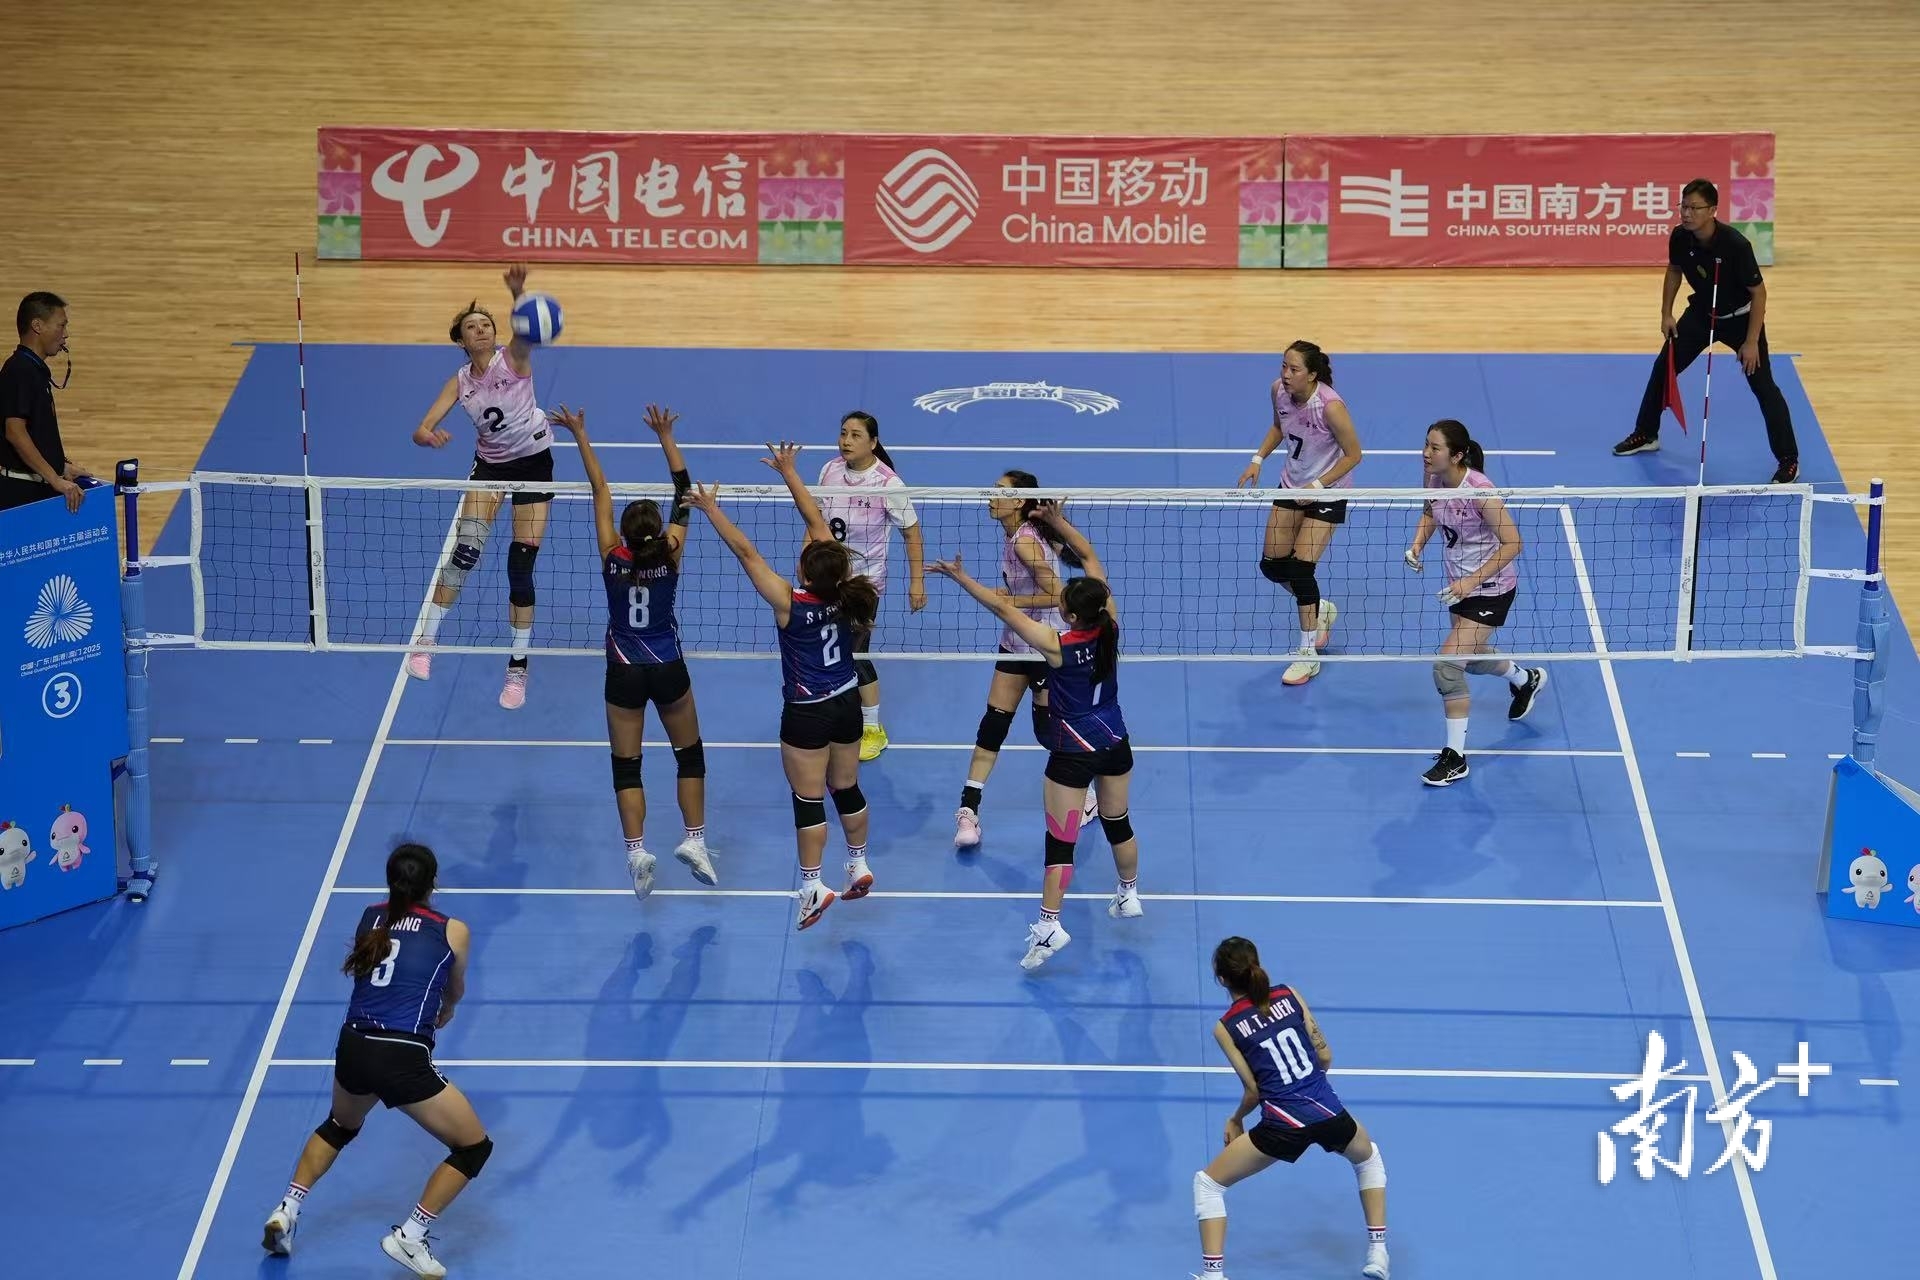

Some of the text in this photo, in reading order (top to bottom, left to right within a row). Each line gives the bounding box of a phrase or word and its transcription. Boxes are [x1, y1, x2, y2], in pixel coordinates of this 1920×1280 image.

[502, 147, 748, 224] 中国电信
[1002, 156, 1208, 207] 中国移动
[1447, 182, 1718, 221] 中国南方电
[502, 227, 748, 249] CHINA TELECOM
[1001, 212, 1206, 244] China Mobile
[1447, 224, 1500, 237] CHINA
[1505, 223, 1600, 237] SOUTHERN
[1606, 223, 1669, 236] POWER
[483, 406, 508, 433] 2
[1289, 433, 1304, 460] 7
[829, 517, 847, 543] 8
[628, 585, 650, 629] 8
[83, 643, 101, 656] 2025
[820, 623, 841, 667] 2
[54, 681, 71, 709] 3
[370, 938, 401, 987] 3
[1236, 1019, 1256, 1038] W.
[1251, 1014, 1268, 1029] T.
[1259, 1027, 1314, 1086] 10
